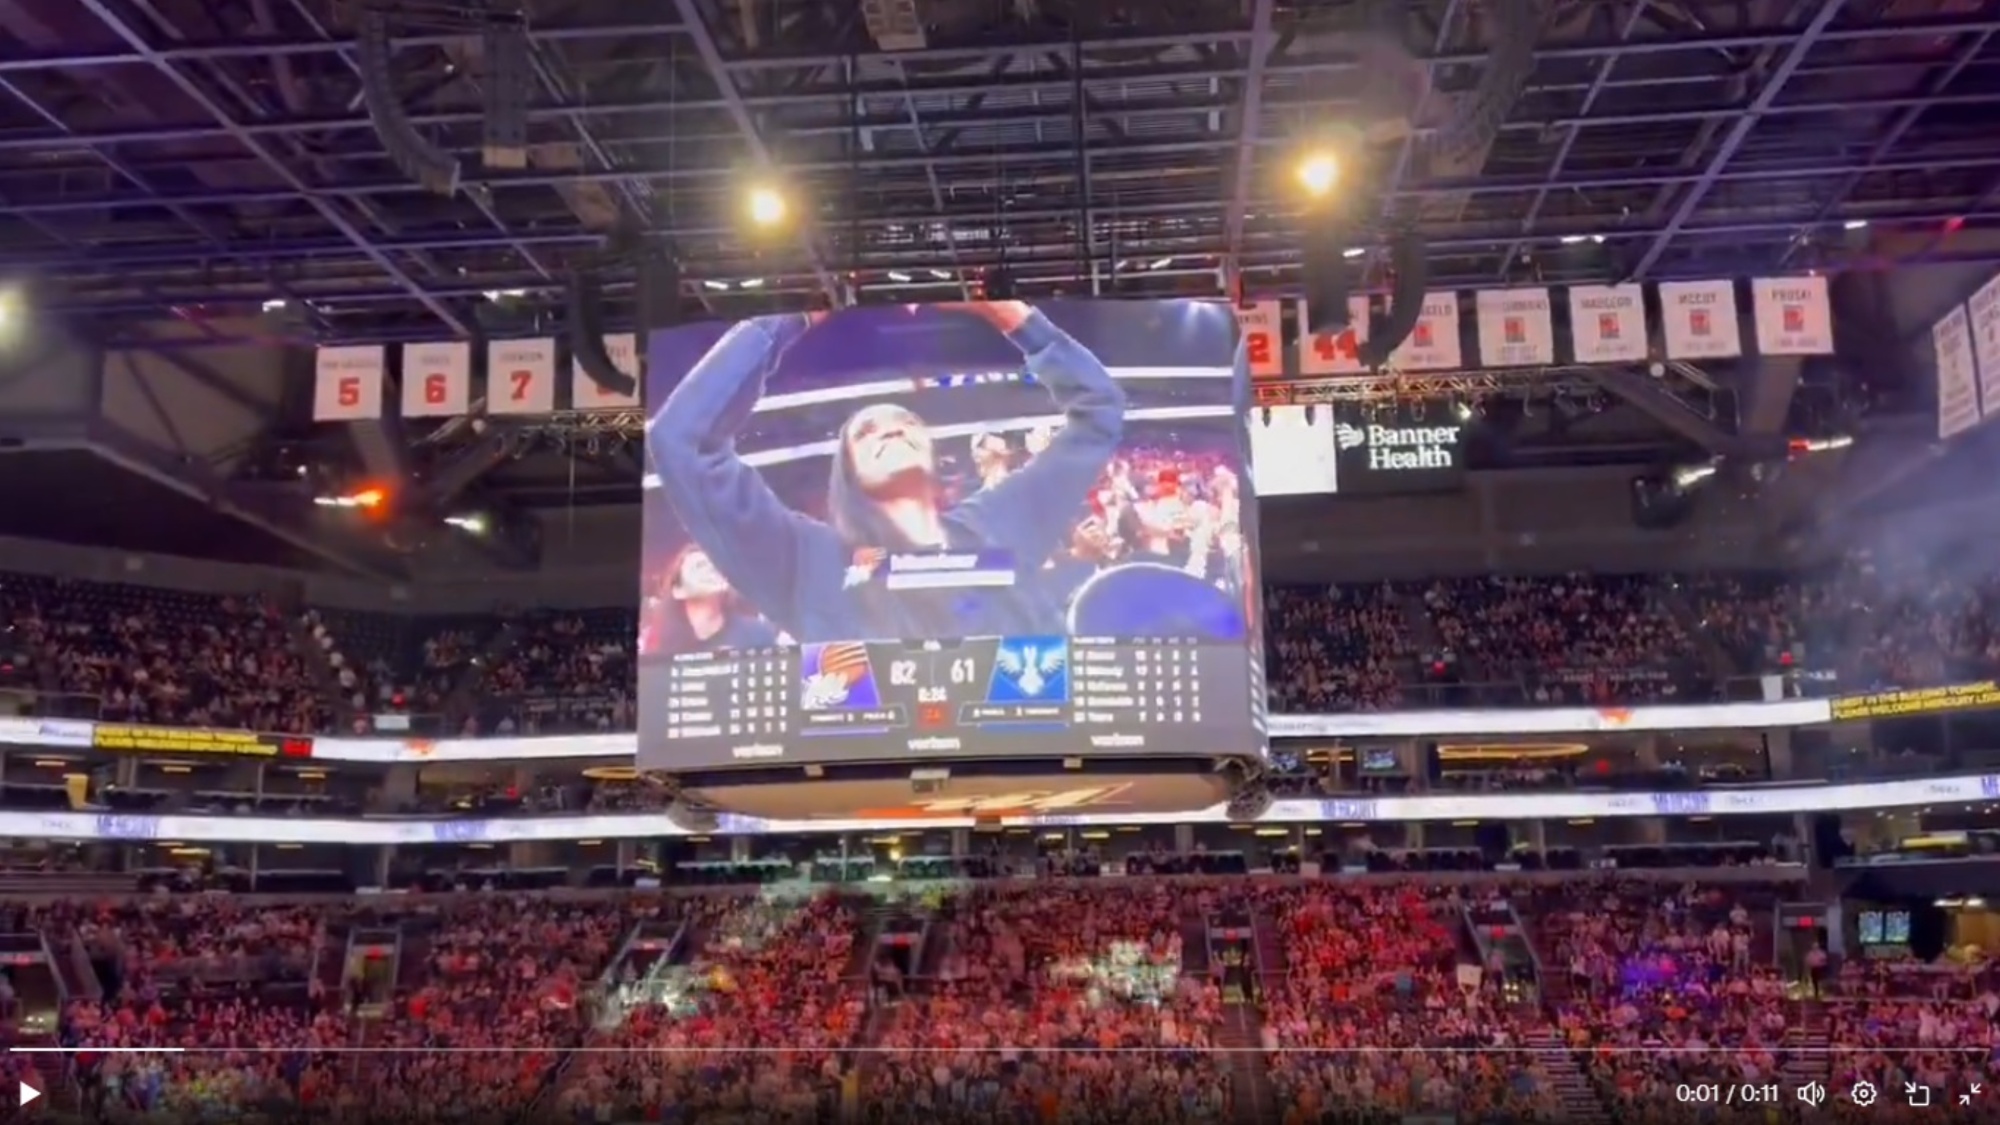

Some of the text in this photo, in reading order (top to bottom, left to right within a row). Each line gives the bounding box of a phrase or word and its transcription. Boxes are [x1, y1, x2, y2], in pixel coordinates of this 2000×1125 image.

[338, 376, 360, 407] 5
[425, 372, 447, 404] 6
[510, 369, 533, 401] 7
[1368, 424, 1460, 447] Banner
[1369, 444, 1453, 470] Health
[891, 660, 917, 686] 82
[950, 658, 976, 684] 61
